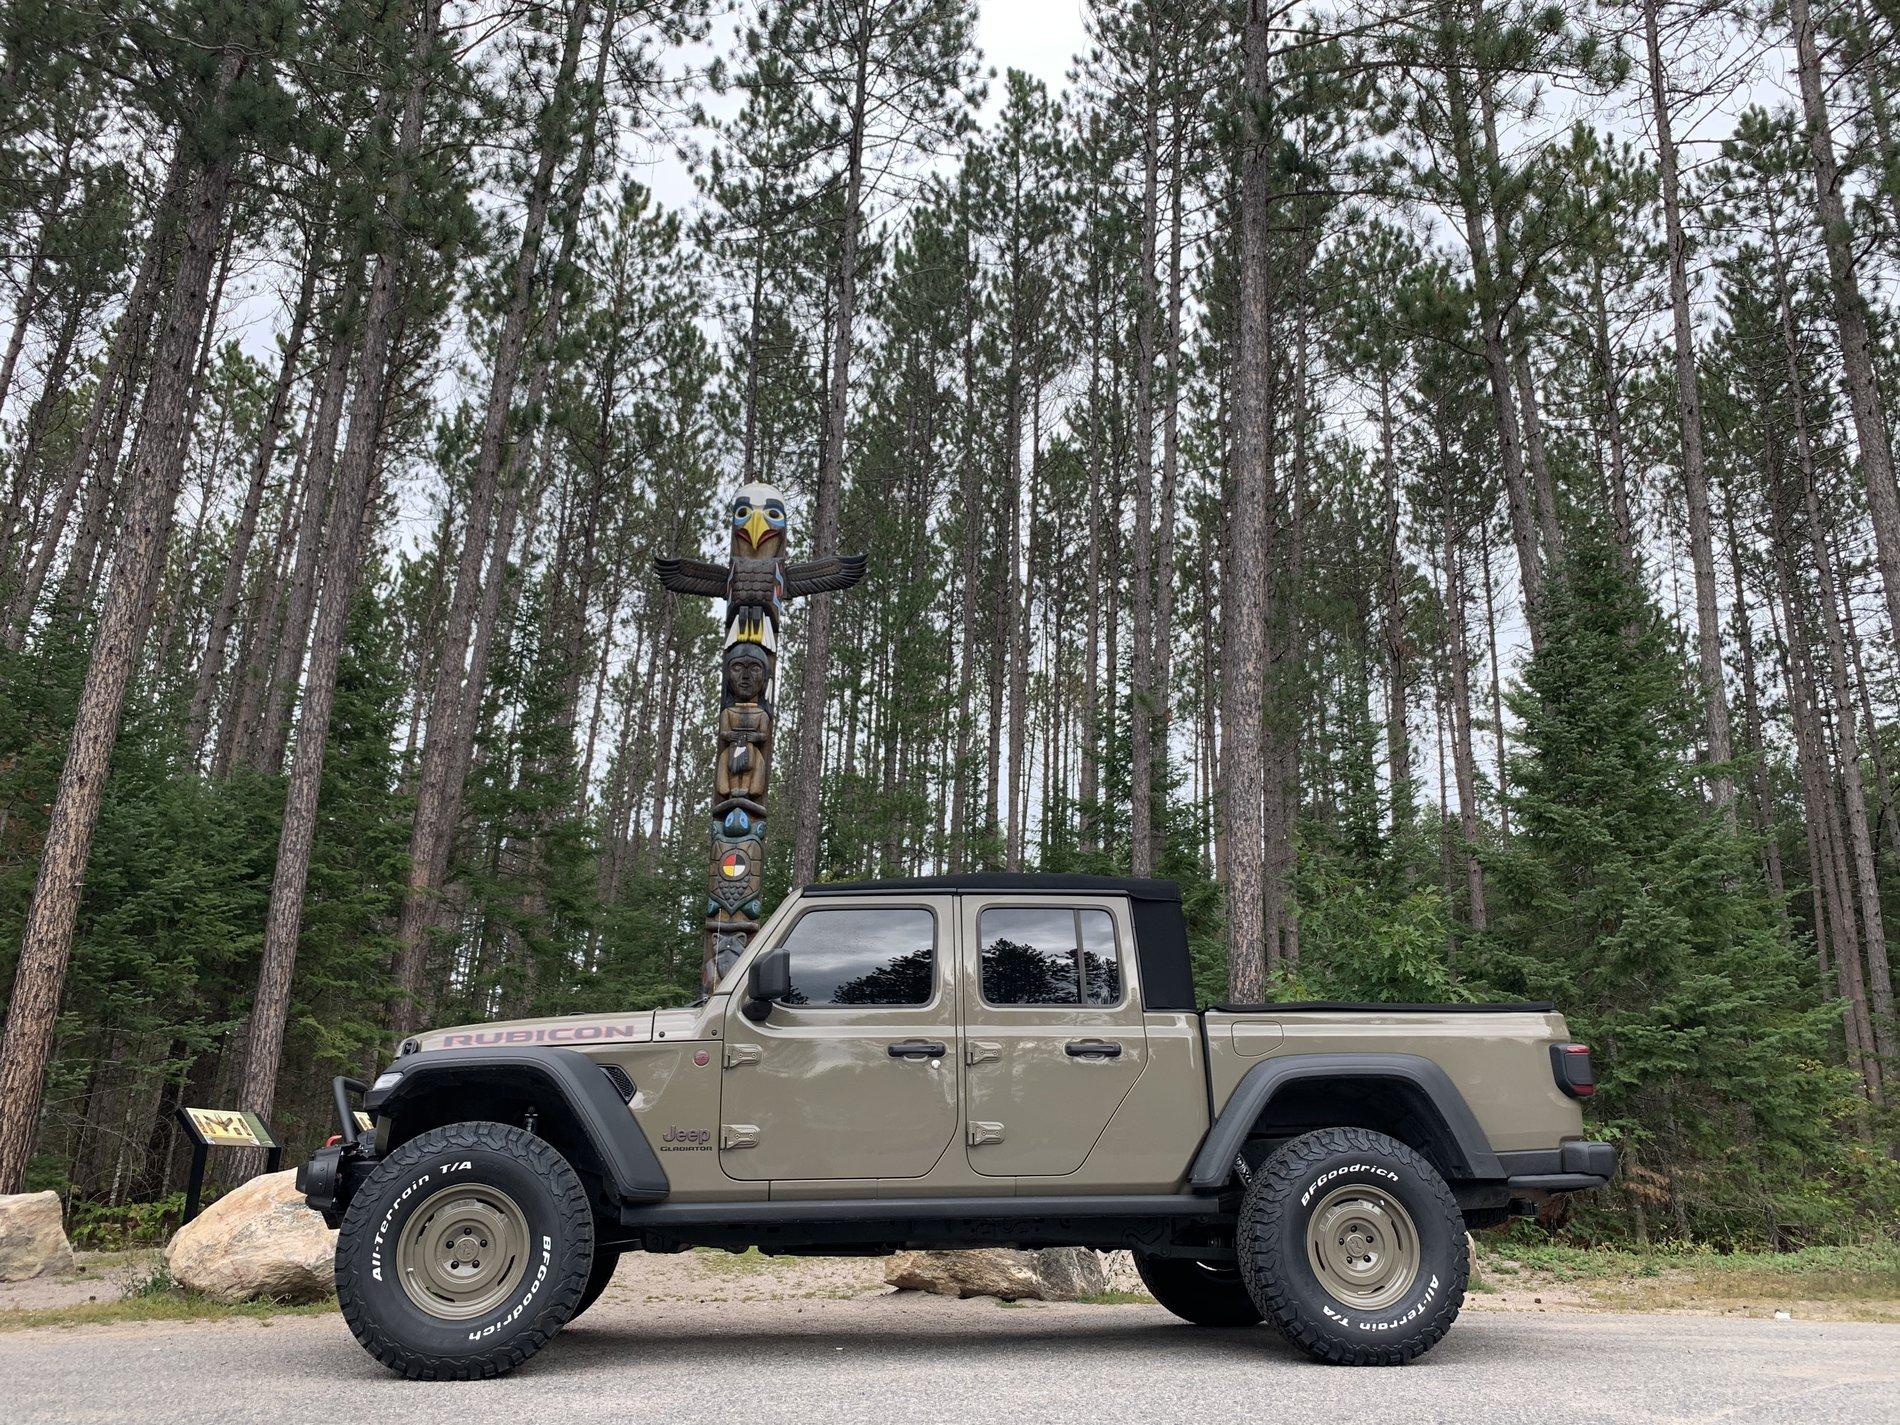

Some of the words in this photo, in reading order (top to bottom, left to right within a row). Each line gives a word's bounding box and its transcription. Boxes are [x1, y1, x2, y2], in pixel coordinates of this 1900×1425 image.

[443, 1025, 634, 1048] RUBICON
[662, 1126, 710, 1145] Jeep
[1300, 1163, 1399, 1207] BFGoodrich
[372, 1174, 430, 1282] All-Terrain
[440, 1161, 472, 1174] T/A
[468, 1235, 552, 1341] BFGoodrich
[1359, 1274, 1440, 1332] All-Terrain
[1322, 1305, 1349, 1327] T/A
